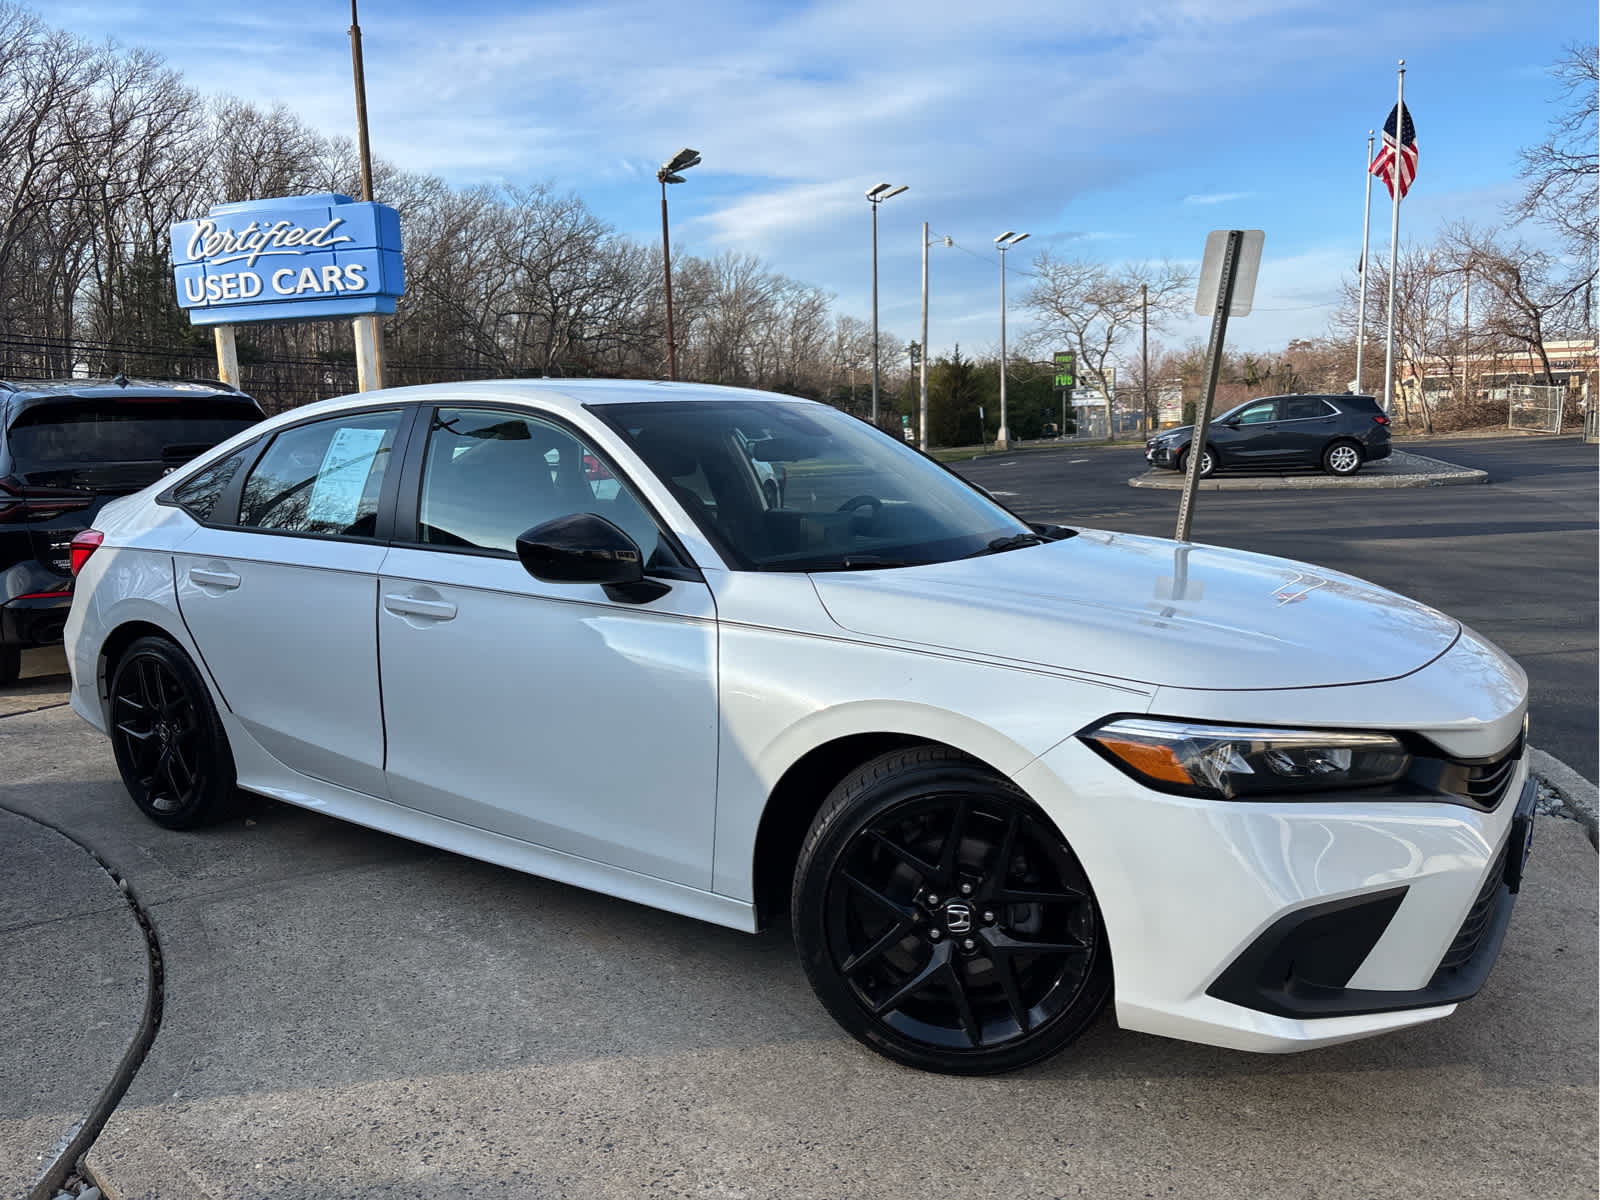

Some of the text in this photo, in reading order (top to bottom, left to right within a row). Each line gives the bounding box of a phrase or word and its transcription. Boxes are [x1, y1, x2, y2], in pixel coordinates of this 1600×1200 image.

[187, 218, 351, 266] Certified
[185, 264, 366, 302] USED CARS
